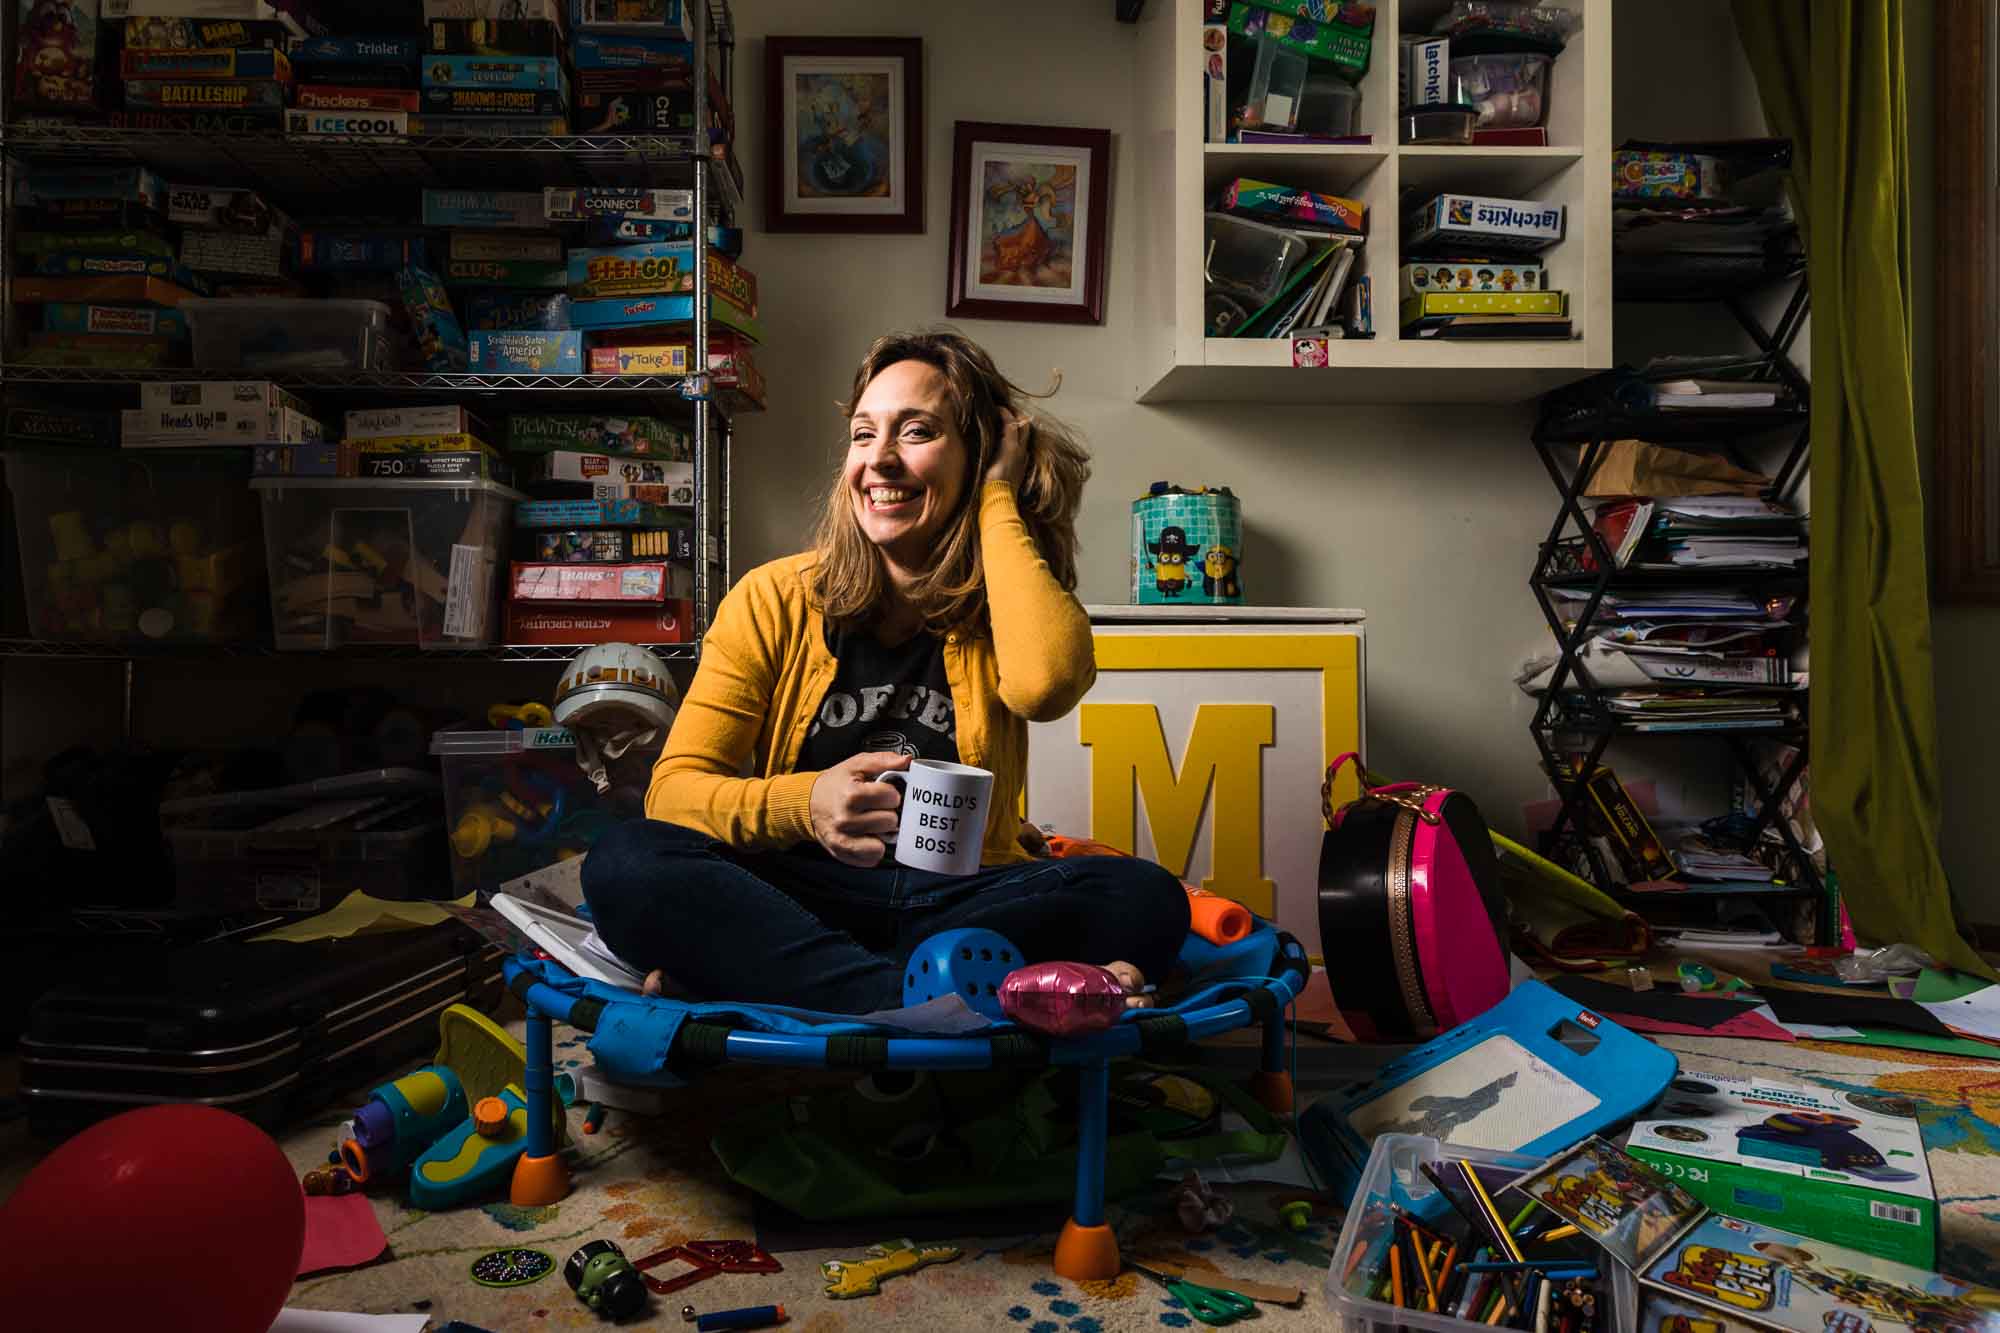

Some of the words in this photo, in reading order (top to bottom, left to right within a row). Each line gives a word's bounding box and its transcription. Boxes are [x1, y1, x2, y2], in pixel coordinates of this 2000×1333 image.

[160, 84, 249, 104] BATTLESHIP
[503, 92, 537, 106] FOREST
[656, 96, 670, 128] Ctrl
[584, 199, 641, 210] CONNECT
[619, 221, 654, 238] CLUE
[502, 345, 542, 358] America
[161, 413, 193, 429] Heads
[196, 412, 214, 430] Up!
[369, 460, 404, 476] 750
[519, 619, 572, 630] CIRCUITRY
[574, 618, 611, 630] ACTION
[806, 683, 955, 739] OFFE
[911, 787, 977, 811] WORLD'S
[1080, 704, 1274, 920] M
[919, 813, 959, 832] BEST
[914, 835, 956, 855] BOSS
[1729, 1089, 1841, 1111] Microscope
[1751, 1087, 1820, 1103] Talking
